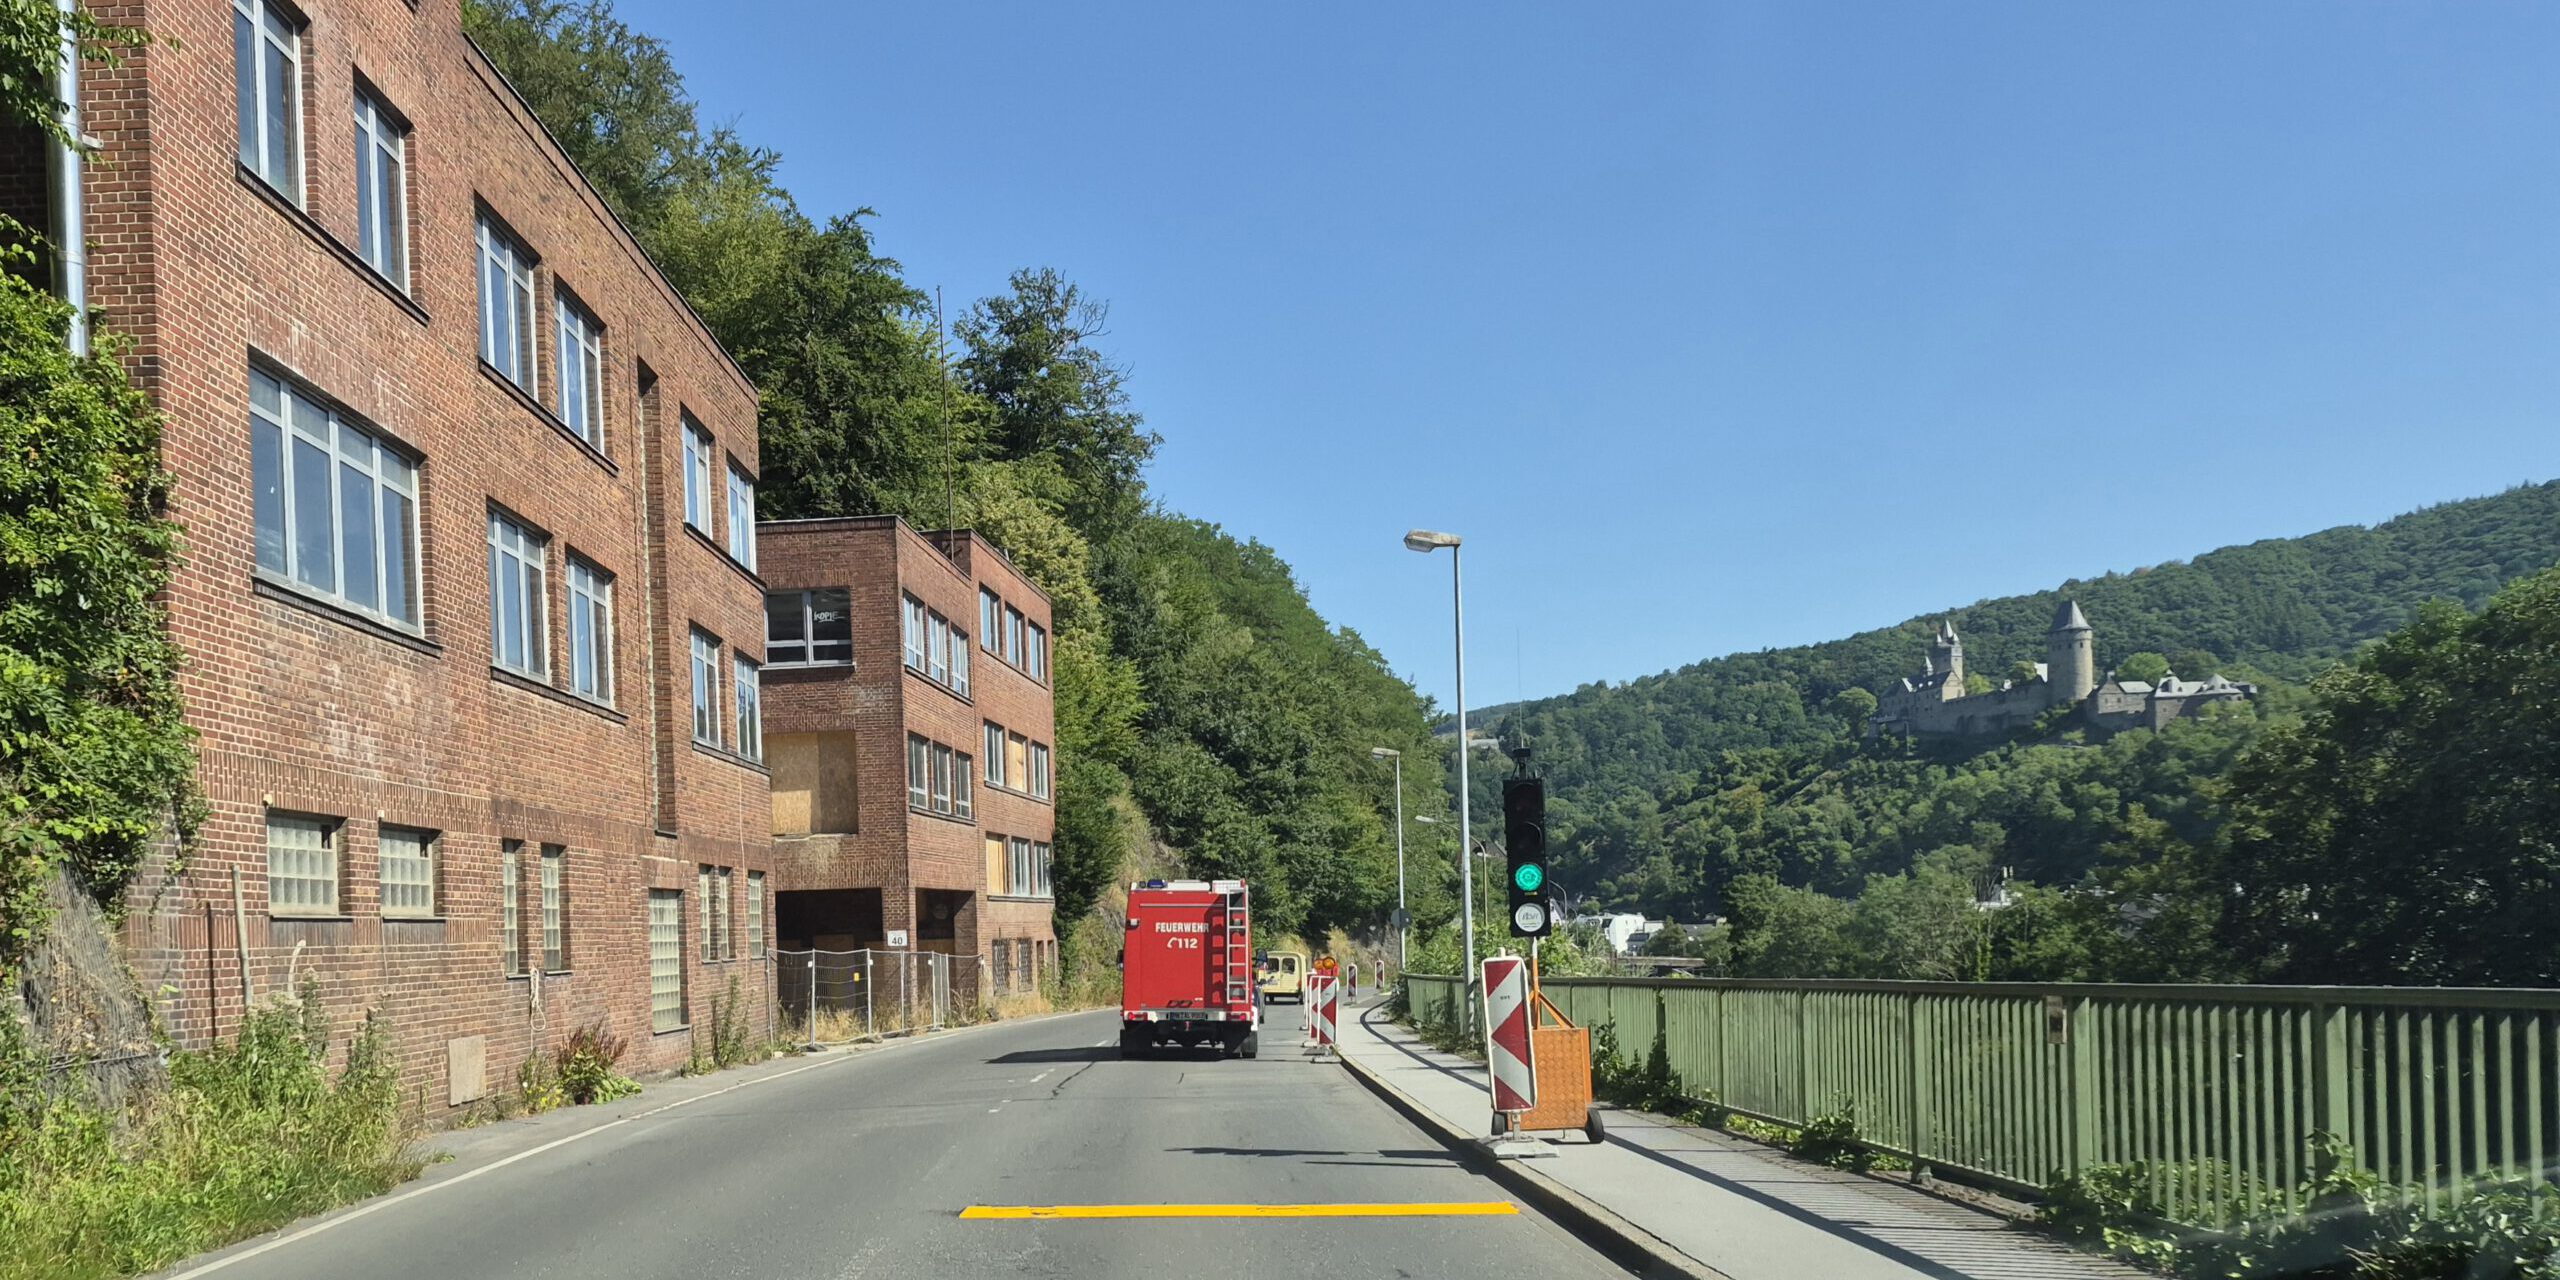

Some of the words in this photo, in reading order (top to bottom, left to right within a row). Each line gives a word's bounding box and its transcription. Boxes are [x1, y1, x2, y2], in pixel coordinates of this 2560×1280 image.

[1155, 922, 1209, 933] FEUERWEHR
[891, 936, 903, 945] 40
[1177, 937, 1198, 949] 112
